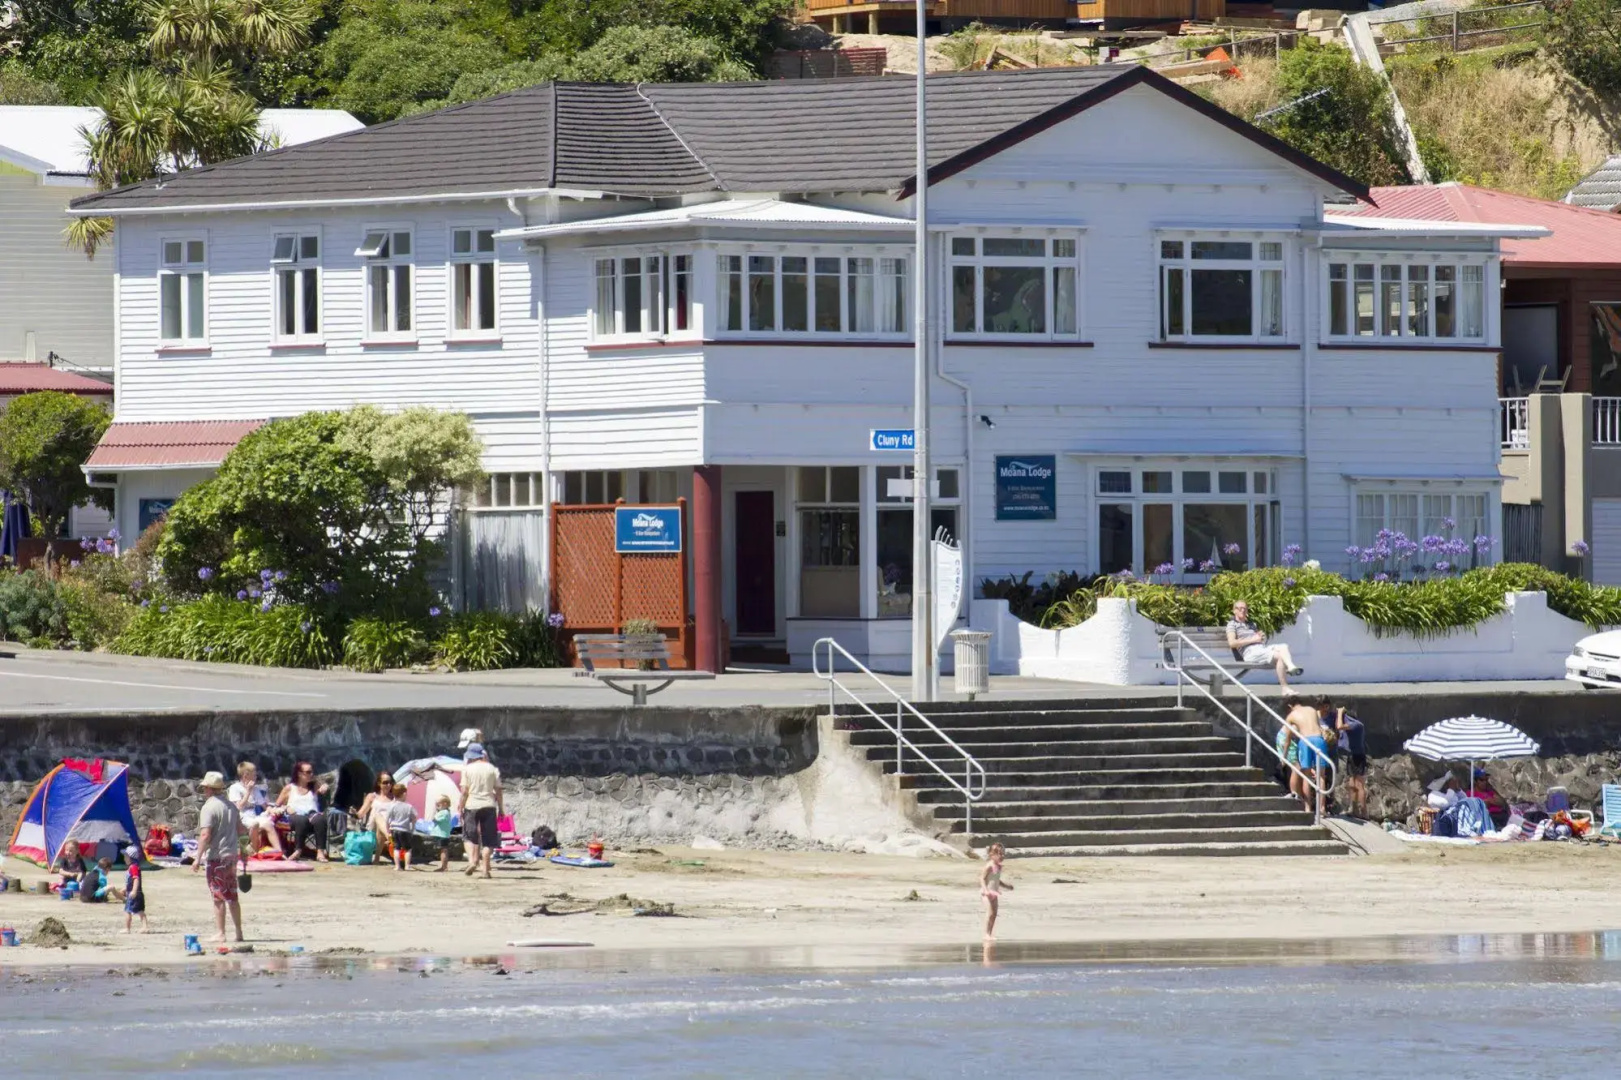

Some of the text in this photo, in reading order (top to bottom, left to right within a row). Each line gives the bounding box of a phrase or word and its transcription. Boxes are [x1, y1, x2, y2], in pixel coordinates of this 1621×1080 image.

[877, 434, 913, 448] Cluny Rd
[1000, 467, 1052, 479] Moana Lodge
[650, 518, 664, 529] Lodge
